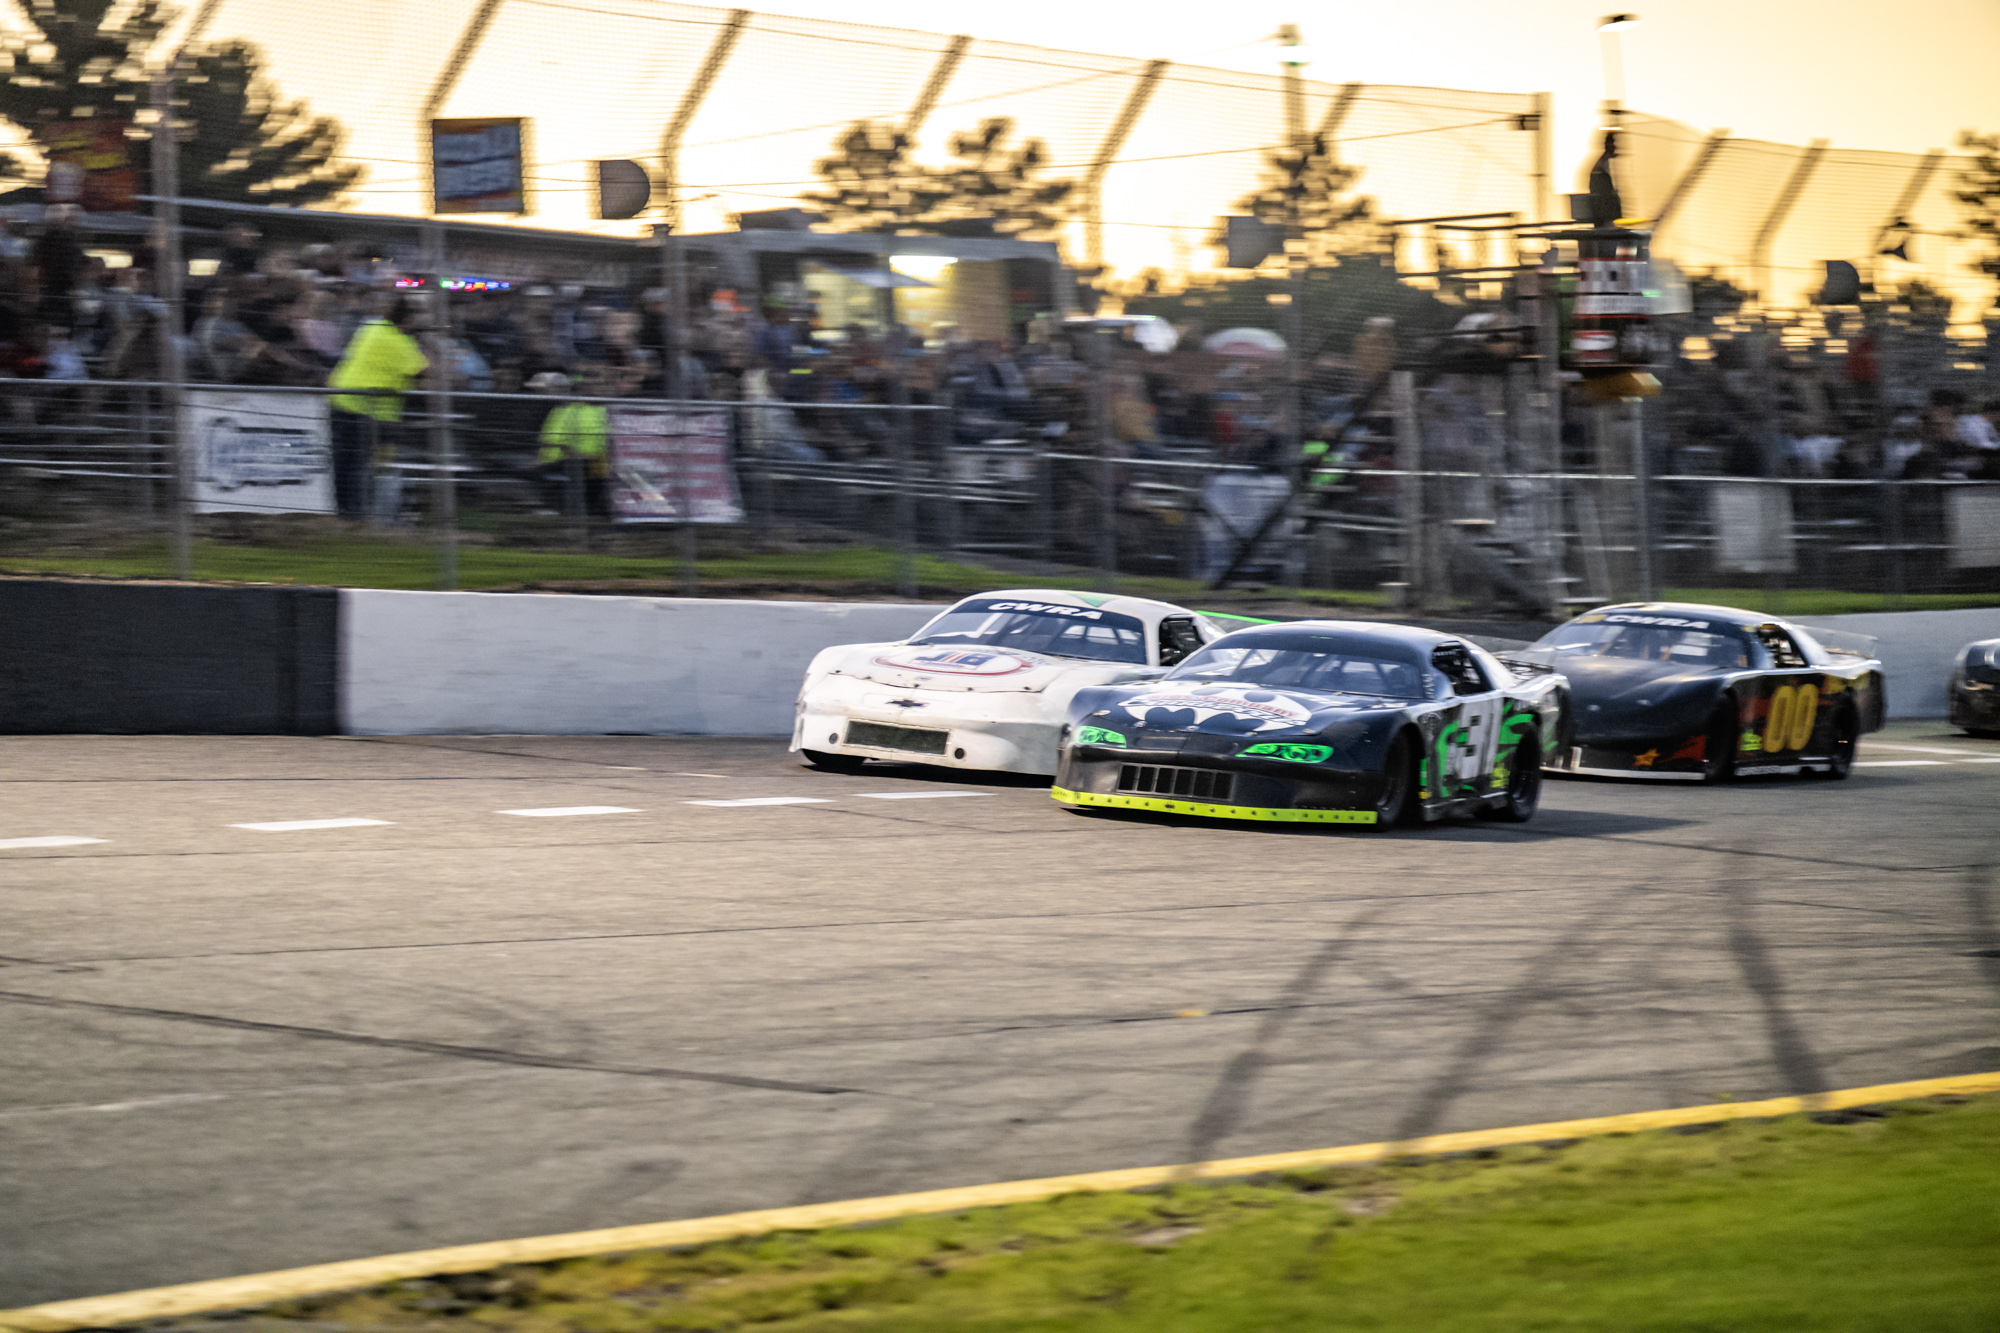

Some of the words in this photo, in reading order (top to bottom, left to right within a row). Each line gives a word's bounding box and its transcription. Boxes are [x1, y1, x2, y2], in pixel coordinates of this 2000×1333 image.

[988, 602, 1103, 620] CWRA
[1604, 614, 1710, 629] CWRA
[1764, 683, 1818, 753] 00
